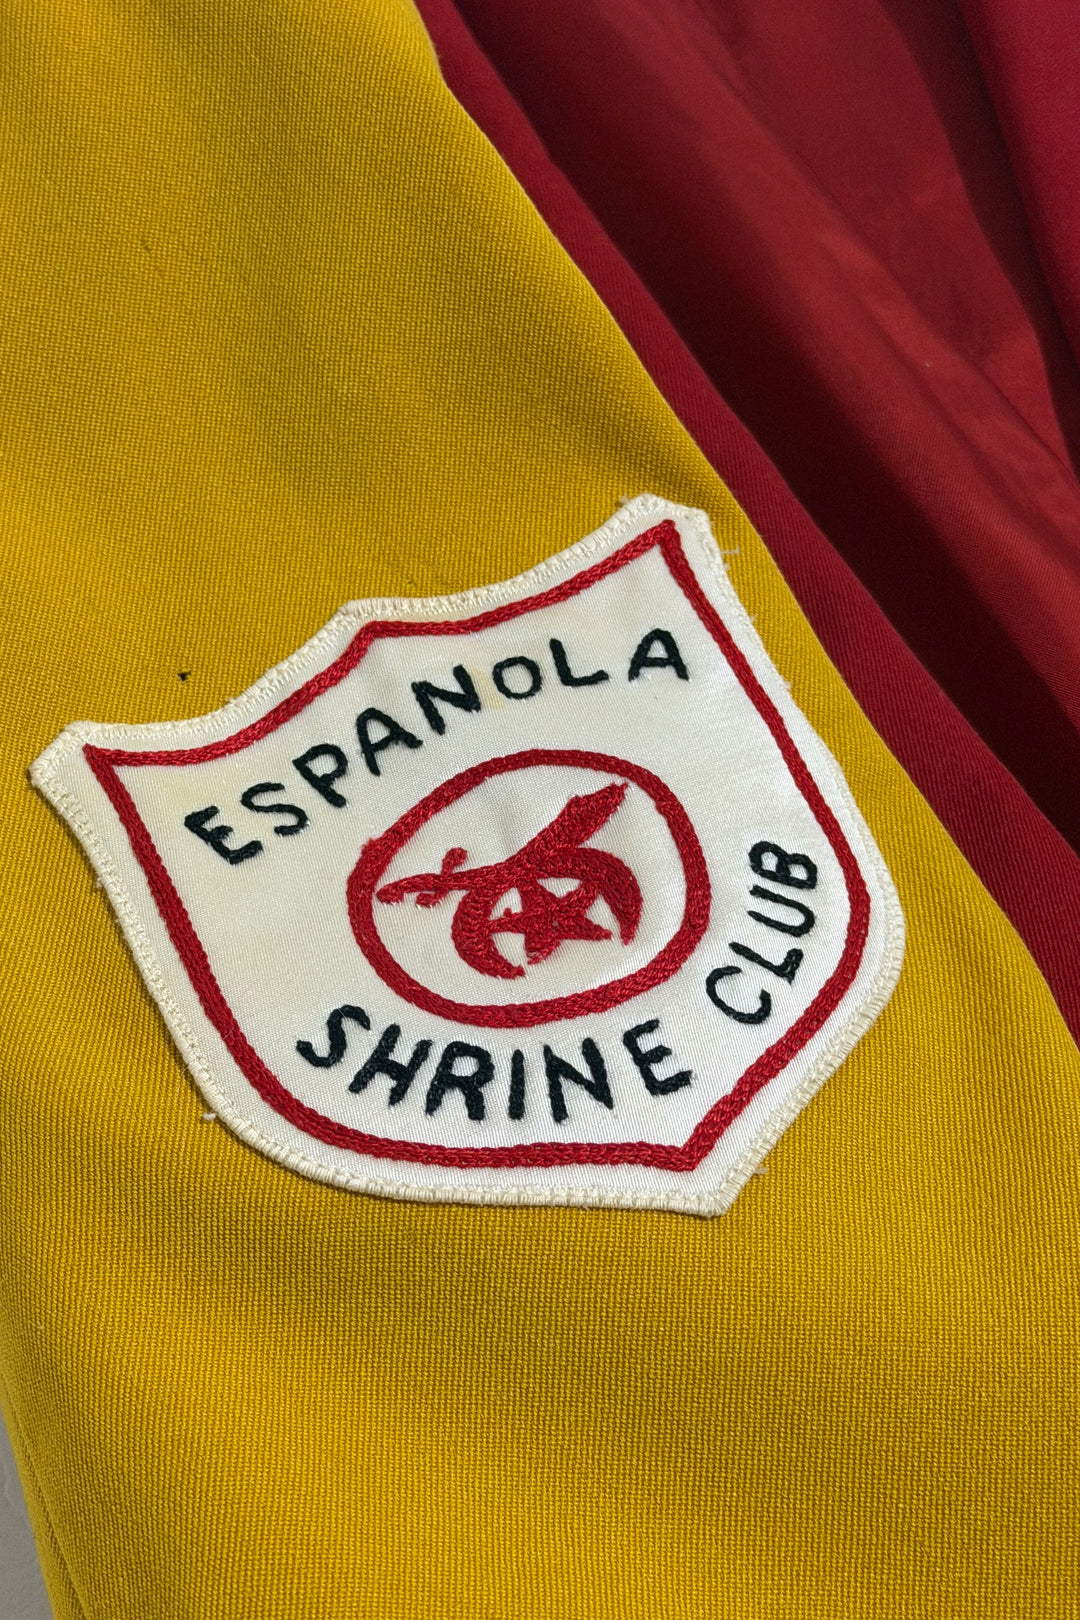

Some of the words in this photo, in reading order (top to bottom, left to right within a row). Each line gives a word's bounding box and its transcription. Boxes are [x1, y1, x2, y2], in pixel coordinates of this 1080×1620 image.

[184, 628, 689, 866] ESPANOLA
[296, 1003, 693, 1126] SHRINE
[705, 840, 818, 1026] CLUB
